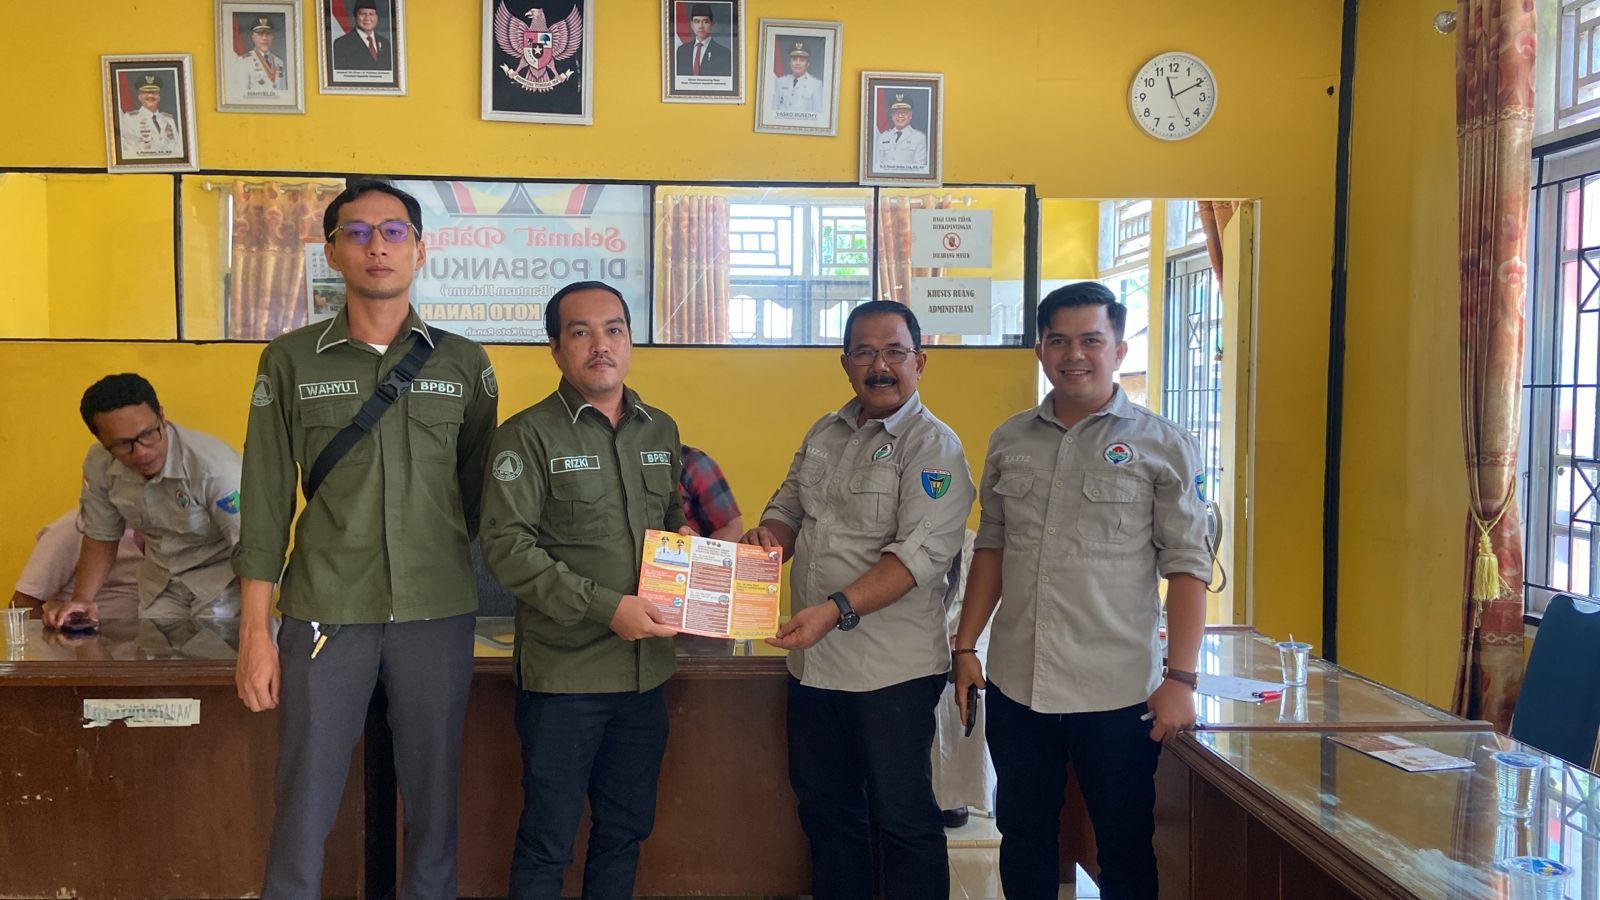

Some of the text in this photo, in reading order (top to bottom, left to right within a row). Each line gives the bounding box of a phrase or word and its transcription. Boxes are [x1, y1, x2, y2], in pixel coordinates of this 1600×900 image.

[1155, 67, 1164, 77] 11
[1169, 62, 1179, 73] 12
[1186, 67, 1191, 77] 1
[1144, 77, 1155, 88] 10
[1195, 77, 1203, 87] 2
[1139, 92, 1146, 102] 9
[1199, 92, 1206, 102] 3
[1143, 107, 1150, 118] 8
[1193, 107, 1200, 117] 4
[1154, 117, 1160, 127] 7
[1168, 122, 1175, 131] 6
[1184, 117, 1191, 127] 5
[927, 289, 975, 298] KHUSUS RUANG
[928, 305, 974, 313] ADMINISTRASI
[306, 383, 351, 396] WAHYU
[420, 380, 455, 394] BPBD
[564, 457, 589, 470] RIZKI
